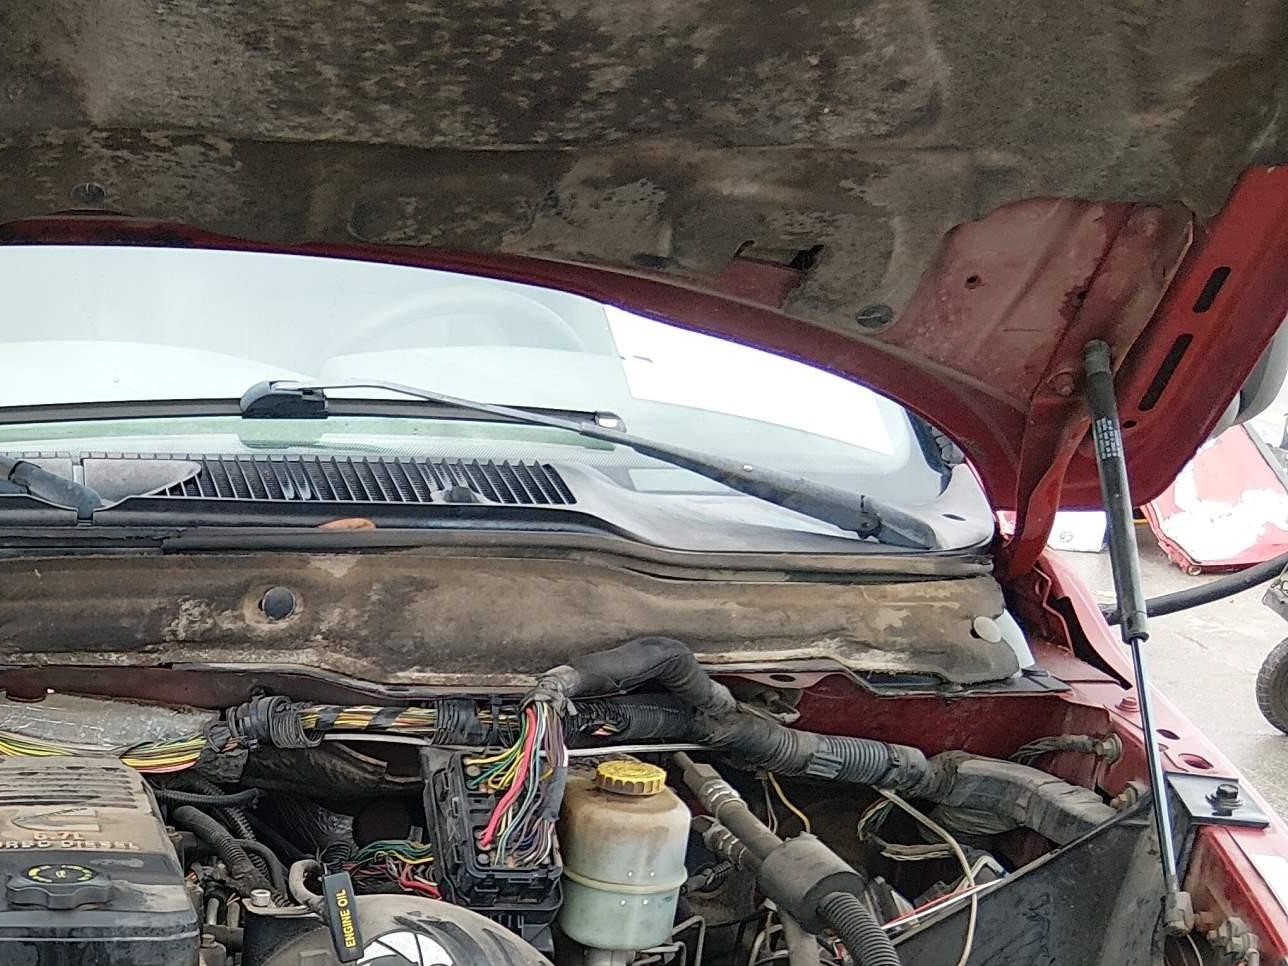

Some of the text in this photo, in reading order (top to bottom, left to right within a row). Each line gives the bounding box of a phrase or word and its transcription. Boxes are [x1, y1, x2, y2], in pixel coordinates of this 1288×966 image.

[61, 840, 141, 851] DIESEL
[335, 888, 357, 948] ENGINE OIL
